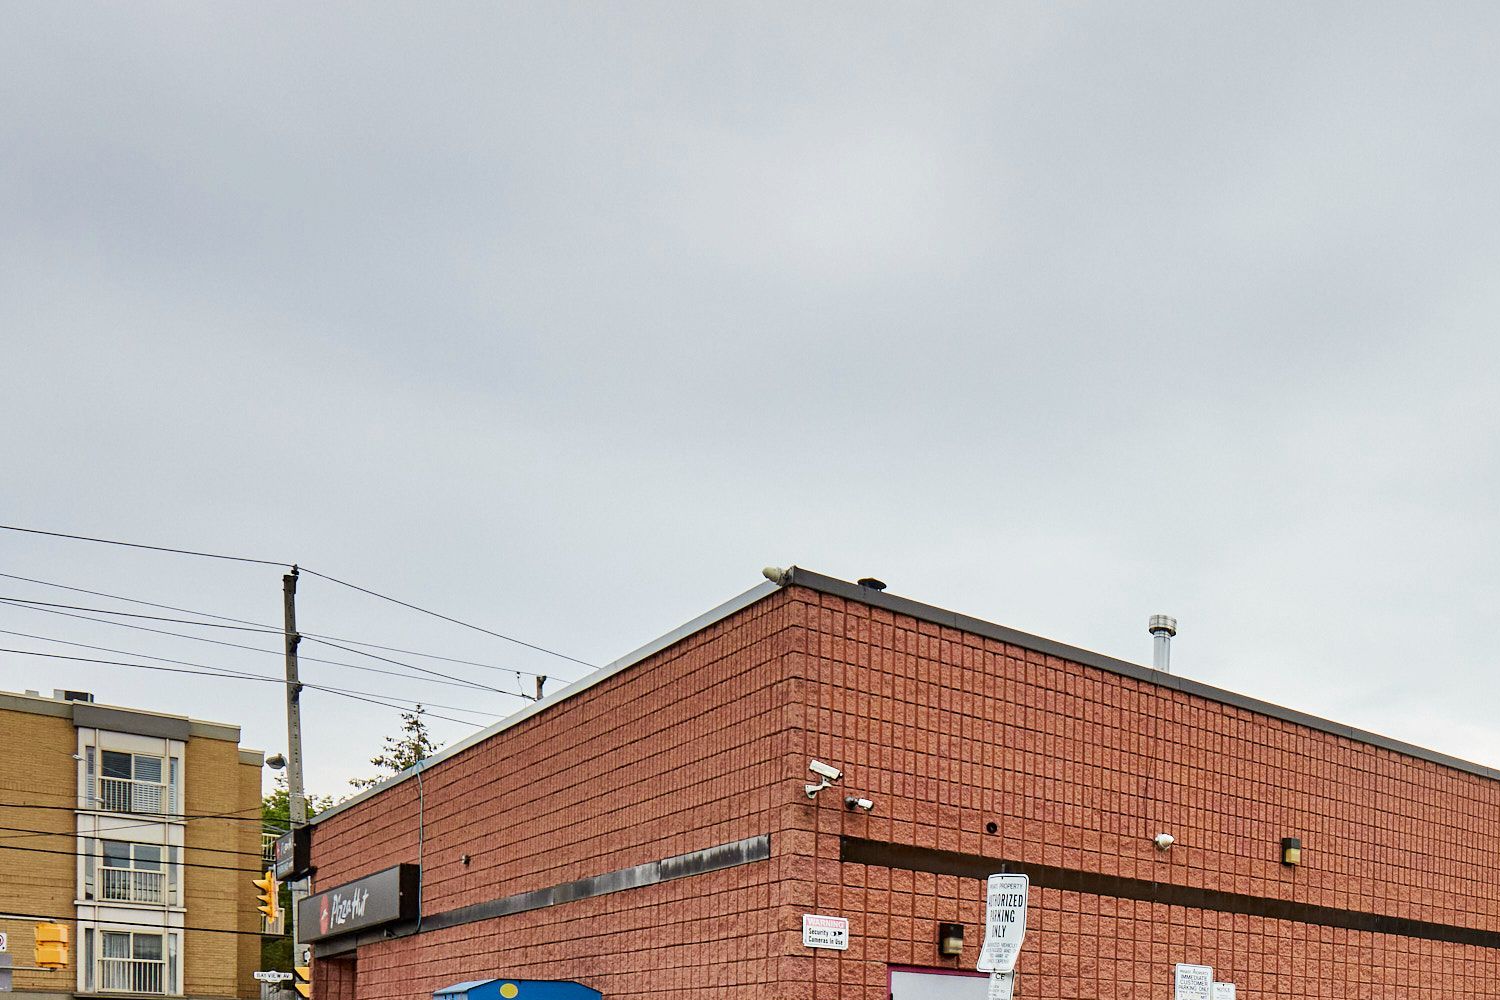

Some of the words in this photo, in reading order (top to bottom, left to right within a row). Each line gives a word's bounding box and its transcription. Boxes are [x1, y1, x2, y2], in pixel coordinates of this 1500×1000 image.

[331, 893, 351, 929] Pizza
[352, 887, 369, 920] Hut
[808, 917, 845, 928] WARNING
[809, 927, 829, 937] Security
[809, 935, 828, 944] Cameras
